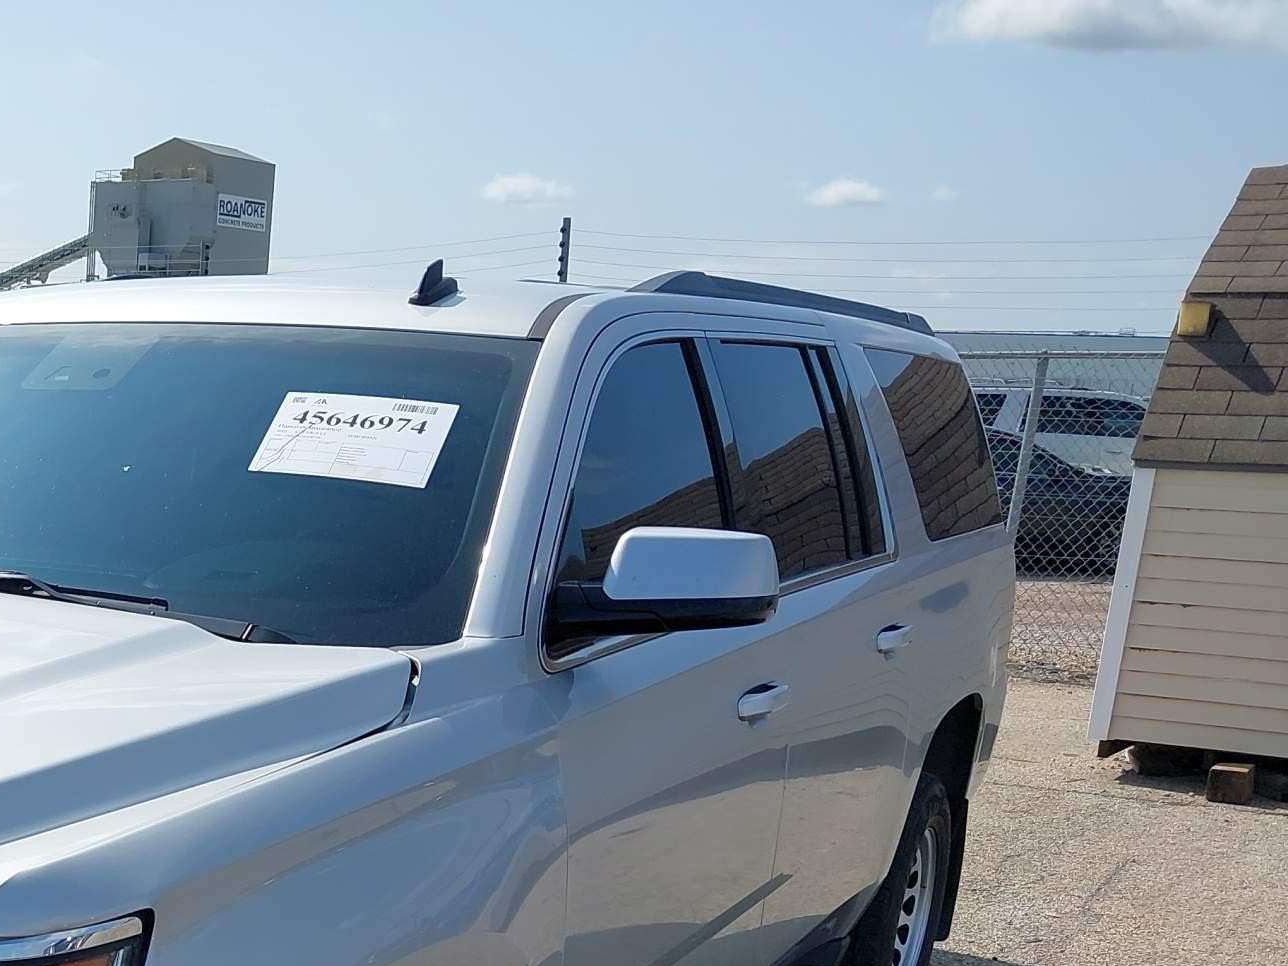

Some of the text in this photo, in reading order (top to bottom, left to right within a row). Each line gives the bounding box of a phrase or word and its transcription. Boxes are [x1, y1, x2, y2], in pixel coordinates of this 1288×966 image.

[219, 199, 266, 218] ROANOKE
[218, 218, 264, 230] CONCRETE PRODUCTS
[292, 409, 428, 435] 45646974
